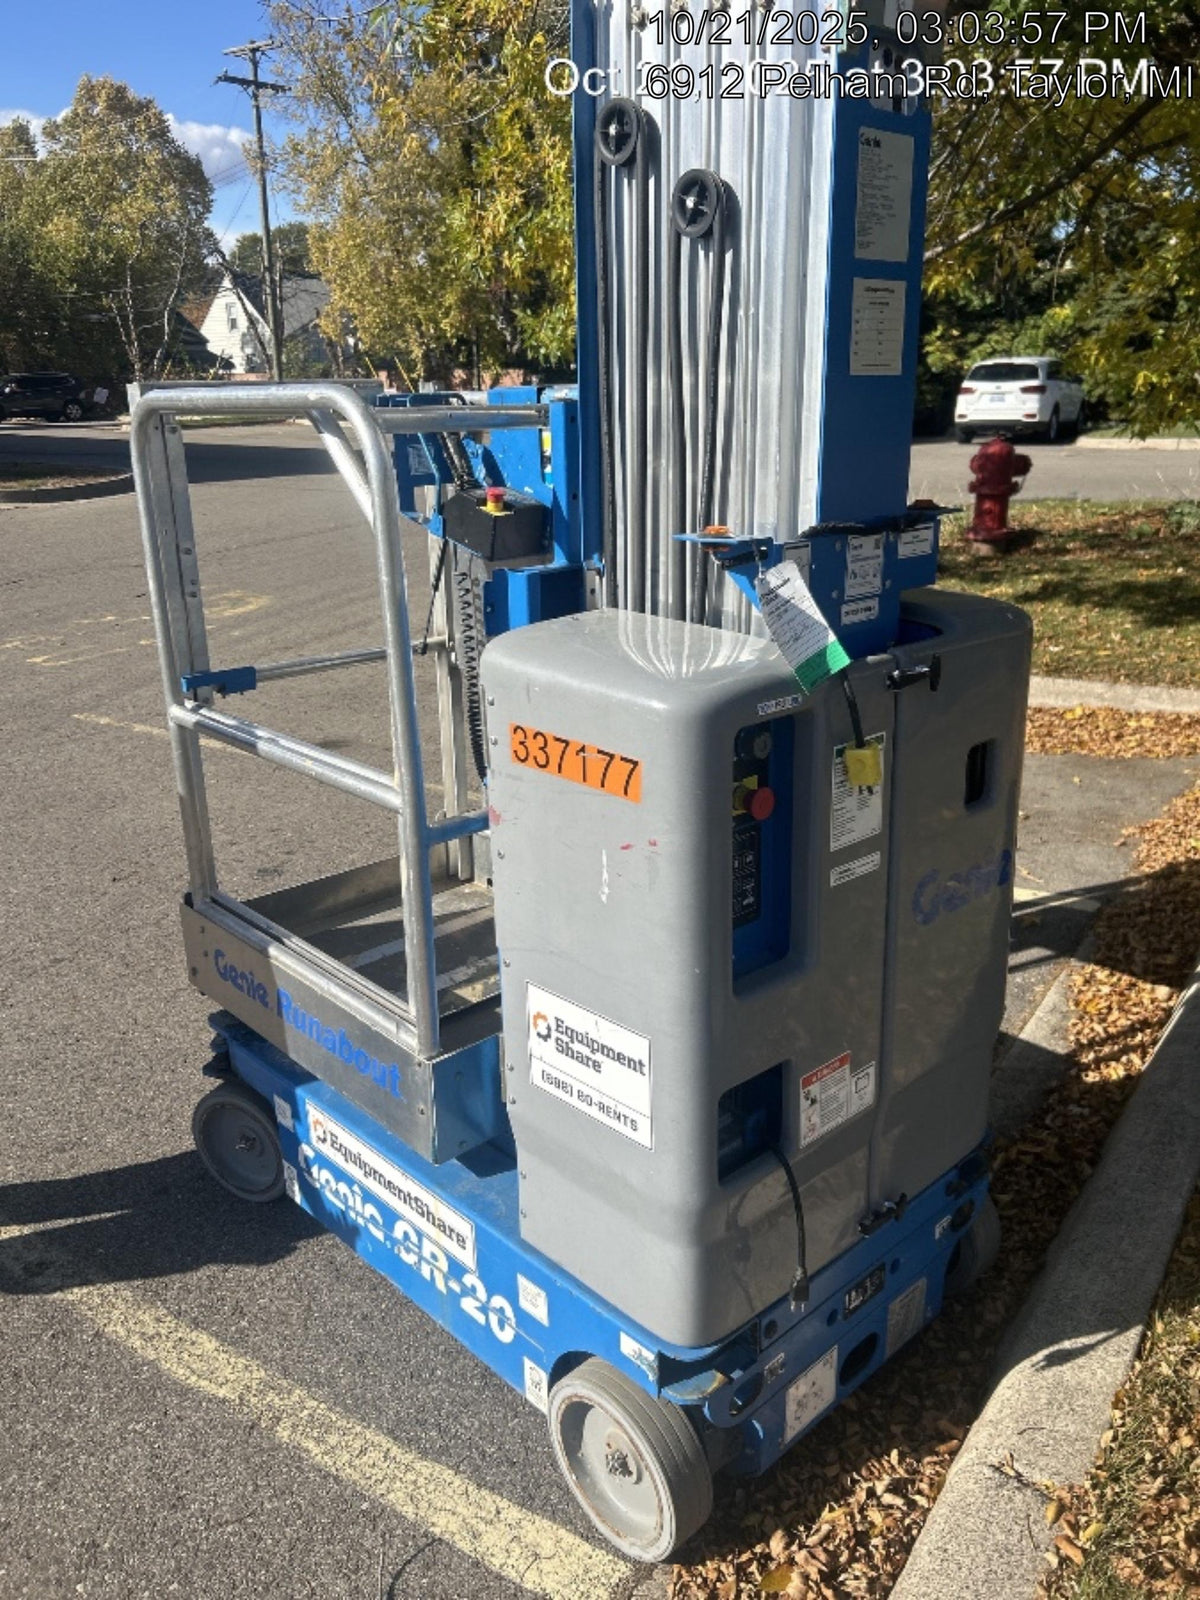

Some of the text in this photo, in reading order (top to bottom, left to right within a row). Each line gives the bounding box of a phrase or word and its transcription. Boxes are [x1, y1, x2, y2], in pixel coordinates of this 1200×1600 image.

[512, 724, 640, 796] 337177
[214, 949, 402, 1099] Genie Runabout
[554, 1016, 647, 1076] Equipment
[554, 1037, 602, 1074] Share
[329, 1131, 468, 1251] EquipmentShare
[393, 1219, 516, 1345] GR-20
